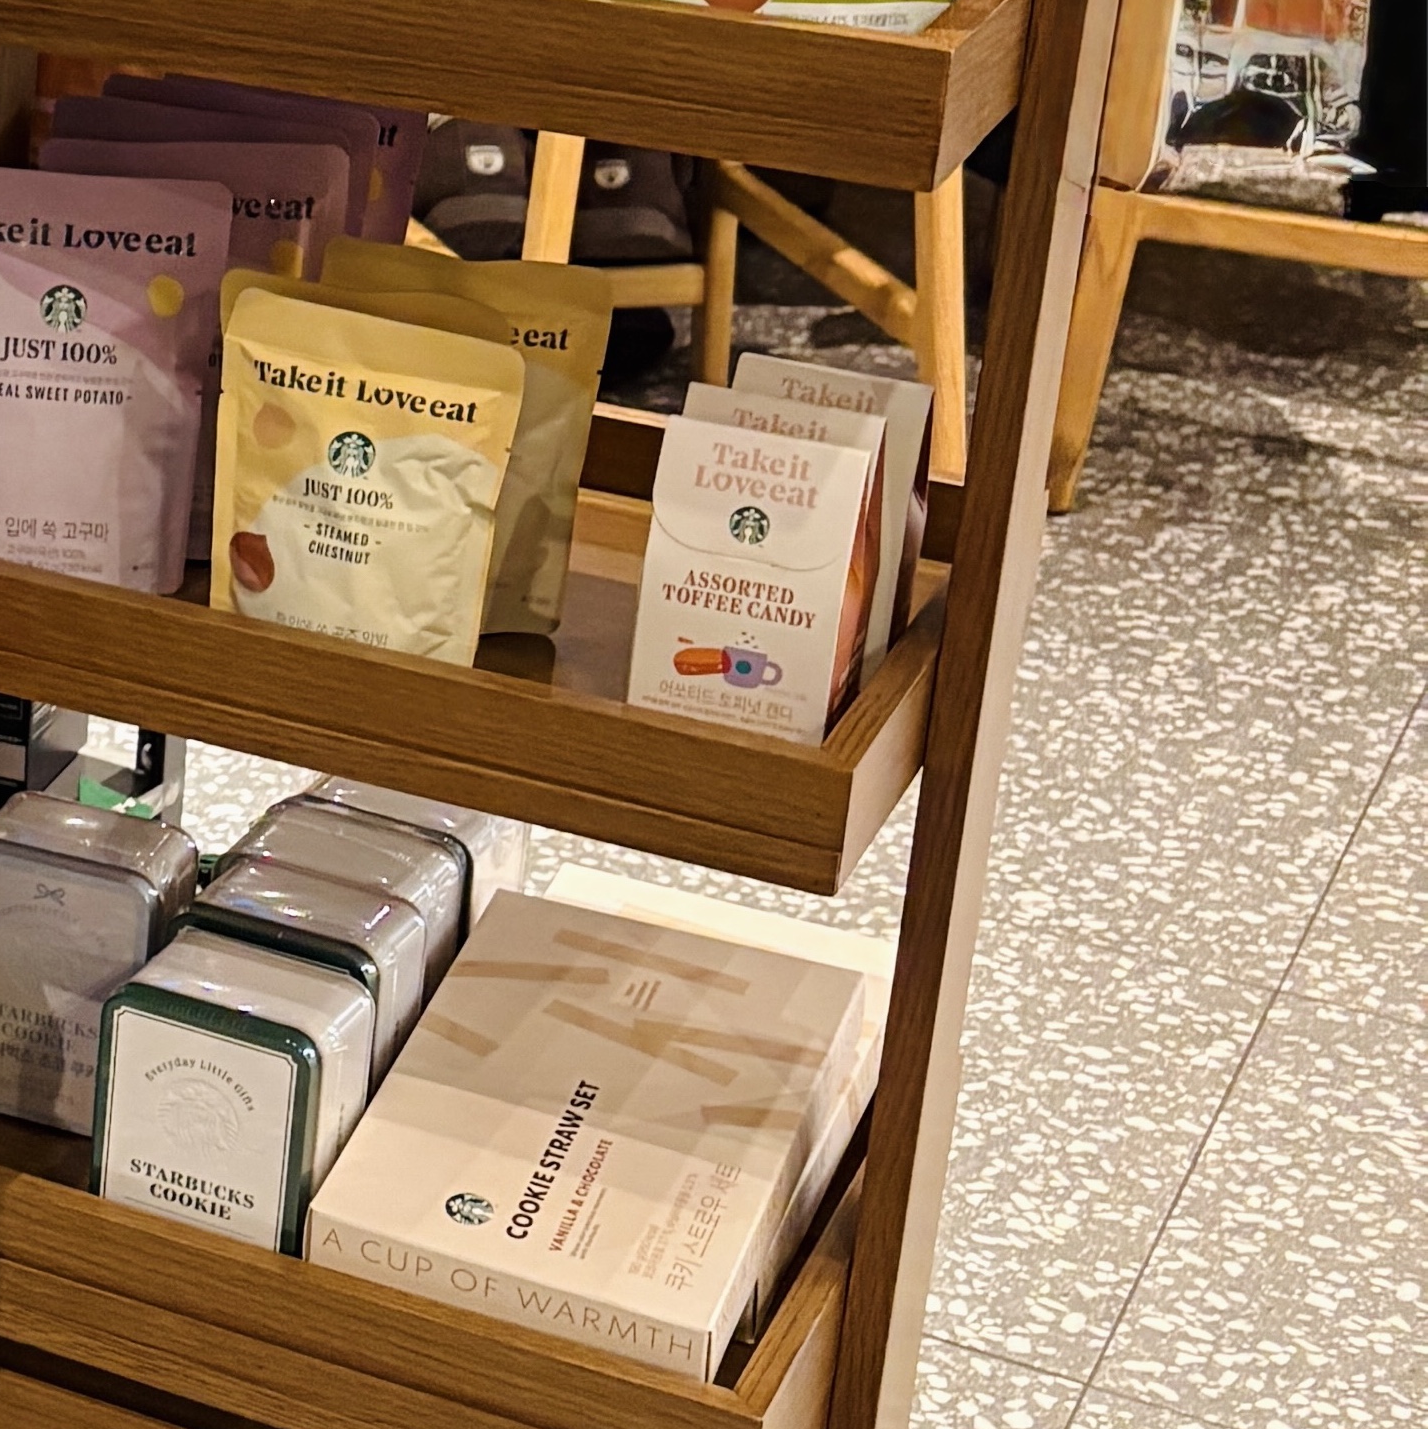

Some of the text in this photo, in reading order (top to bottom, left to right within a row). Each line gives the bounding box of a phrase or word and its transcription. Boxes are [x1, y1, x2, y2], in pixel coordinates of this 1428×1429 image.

[0, 336, 118, 365] JUST 100%
[25, 385, 69, 403] SWEET
[303, 477, 395, 511] JUST 100%
[5, 517, 38, 539] 입에
[43, 520, 58, 542] 쏙
[64, 521, 111, 543] 고구마
[315, 521, 370, 548] STEAMED
[308, 540, 371, 567] CHESTNUT
[661, 583, 817, 629] TOFFEE CANDY
[683, 569, 796, 606] ASSORTED
[145, 1057, 256, 1113] Everyday Little Gifts
[506, 1080, 600, 1240] COOKIE STRAW SET
[129, 1158, 256, 1210] STARBUCKS
[148, 1182, 232, 1222] COOKIE
[549, 1208, 579, 1253] VANILLA
[579, 1138, 614, 1199] CHOCOLATE
[664, 1256, 703, 1293] 쿠키
[685, 1194, 724, 1259] 스트로우
[322, 1227, 694, 1362] A CUP OF WARMTH
